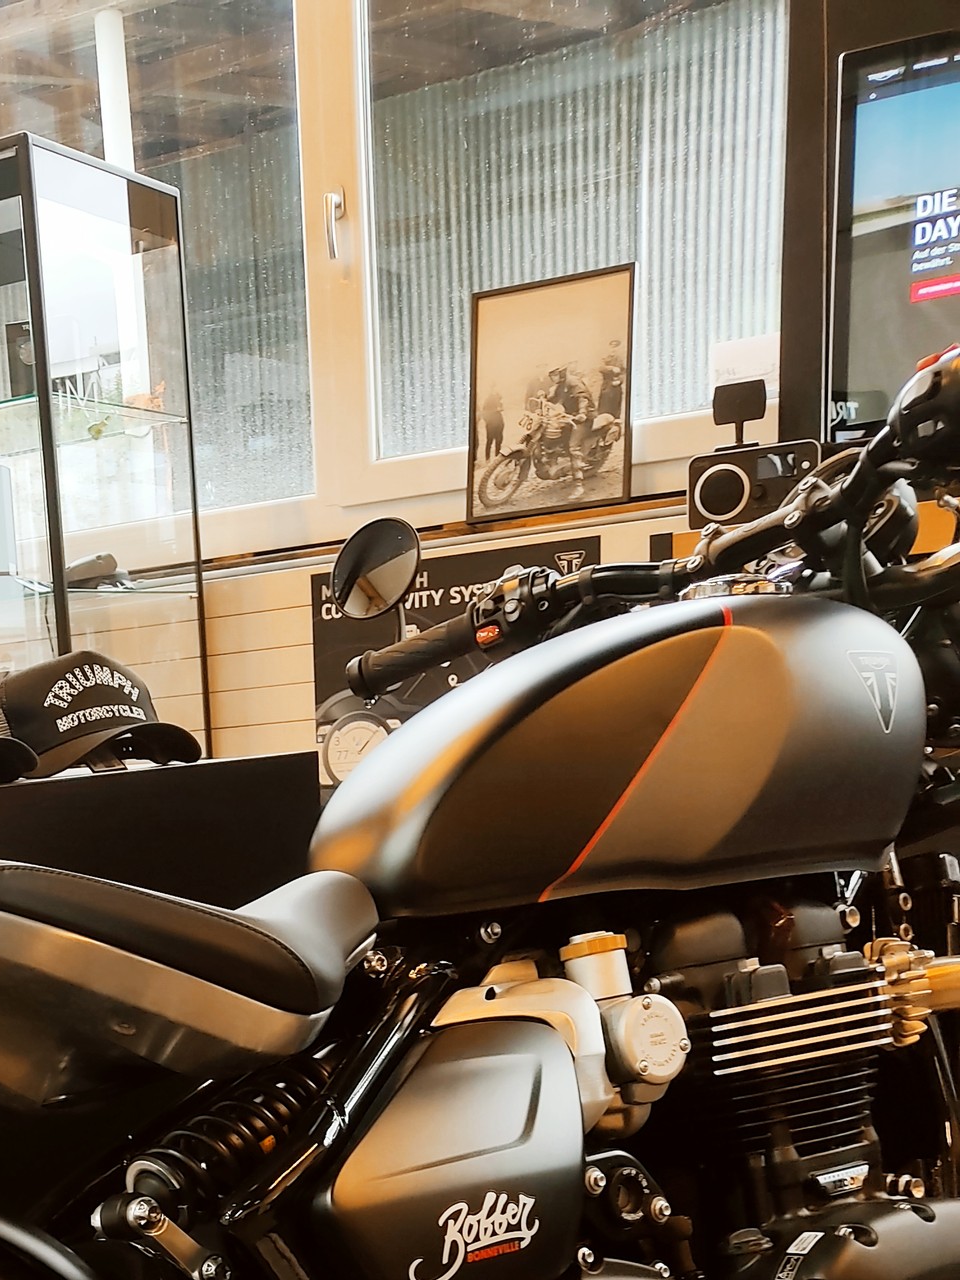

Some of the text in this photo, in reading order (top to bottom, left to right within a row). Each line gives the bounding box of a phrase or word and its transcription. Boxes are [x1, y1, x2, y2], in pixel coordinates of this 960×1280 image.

[916, 189, 957, 219] DIE
[914, 215, 960, 246] DAY
[43, 664, 140, 709] TRIUMPH
[56, 705, 146, 732] MOTORCYCLES
[466, 1240, 520, 1264] BONNEVILLE
